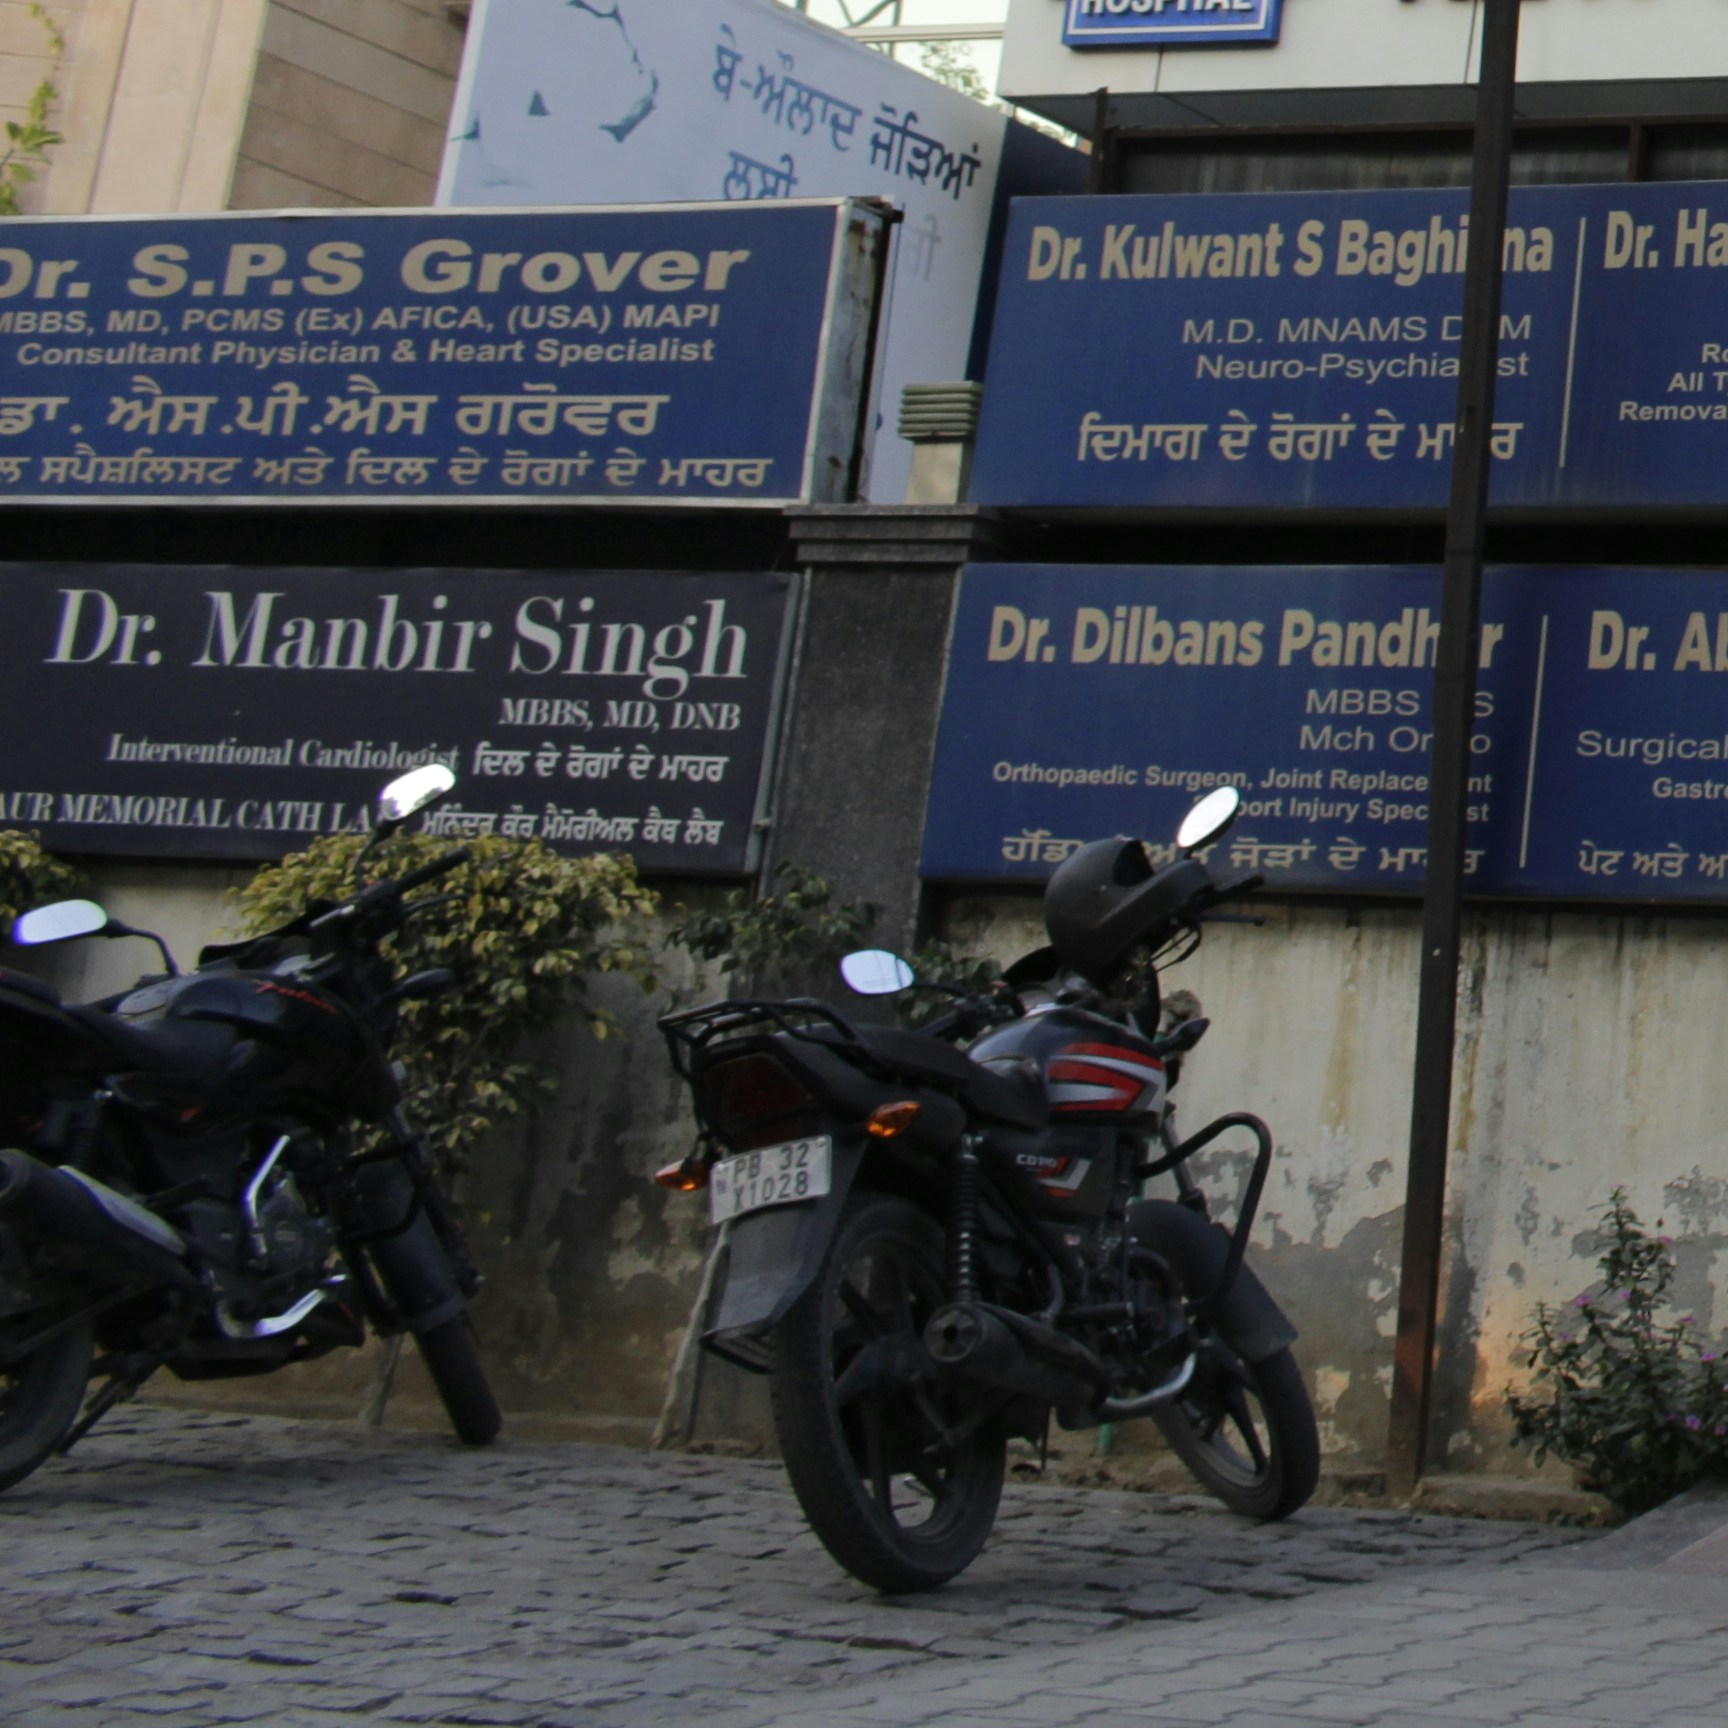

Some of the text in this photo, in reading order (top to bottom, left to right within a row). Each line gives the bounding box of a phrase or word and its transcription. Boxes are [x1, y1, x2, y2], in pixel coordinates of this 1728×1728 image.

[1027, 219, 1325, 281] Dr. Kulwant S
[1603, 210, 1659, 270] Dr.
[127, 238, 752, 297] S.P.S Grover
[107, 309, 170, 336] MD,
[181, 308, 284, 333] PCMS
[294, 306, 364, 336] (Ex)
[371, 305, 495, 333] AFICA,
[507, 305, 612, 334] (USA)
[622, 304, 720, 328] MAPI
[1181, 316, 1427, 344] M.D. MNAMS
[17, 338, 716, 370] Consultant Physician & Heart Specialist
[1667, 371, 1705, 393] All
[1217, 409, 1257, 461] ਦੇ
[1366, 409, 1404, 462] ਦੇ
[252, 446, 334, 486] ਅਤੇ
[346, 447, 439, 485] ਦਿਲ
[449, 447, 489, 485] ਦੇ
[605, 447, 646, 486] ਦੇ
[657, 458, 774, 487] ਮਾਹਰ
[43, 589, 748, 700] Dr. Manbir Singh
[987, 605, 1264, 668] Dr. Dilbans
[1587, 610, 1656, 671] Dr.
[498, 697, 741, 734] MBBS, MD, DNB
[1304, 688, 1420, 716] MBBS
[106, 732, 460, 774] Interventional Cardiologist
[1299, 724, 1375, 752] Mch
[992, 760, 1323, 791] Orthopaedic Surgeon, Joint
[57, 792, 231, 829] MEMORIAL
[236, 800, 322, 833] CATH
[1289, 797, 1361, 825] Injury
